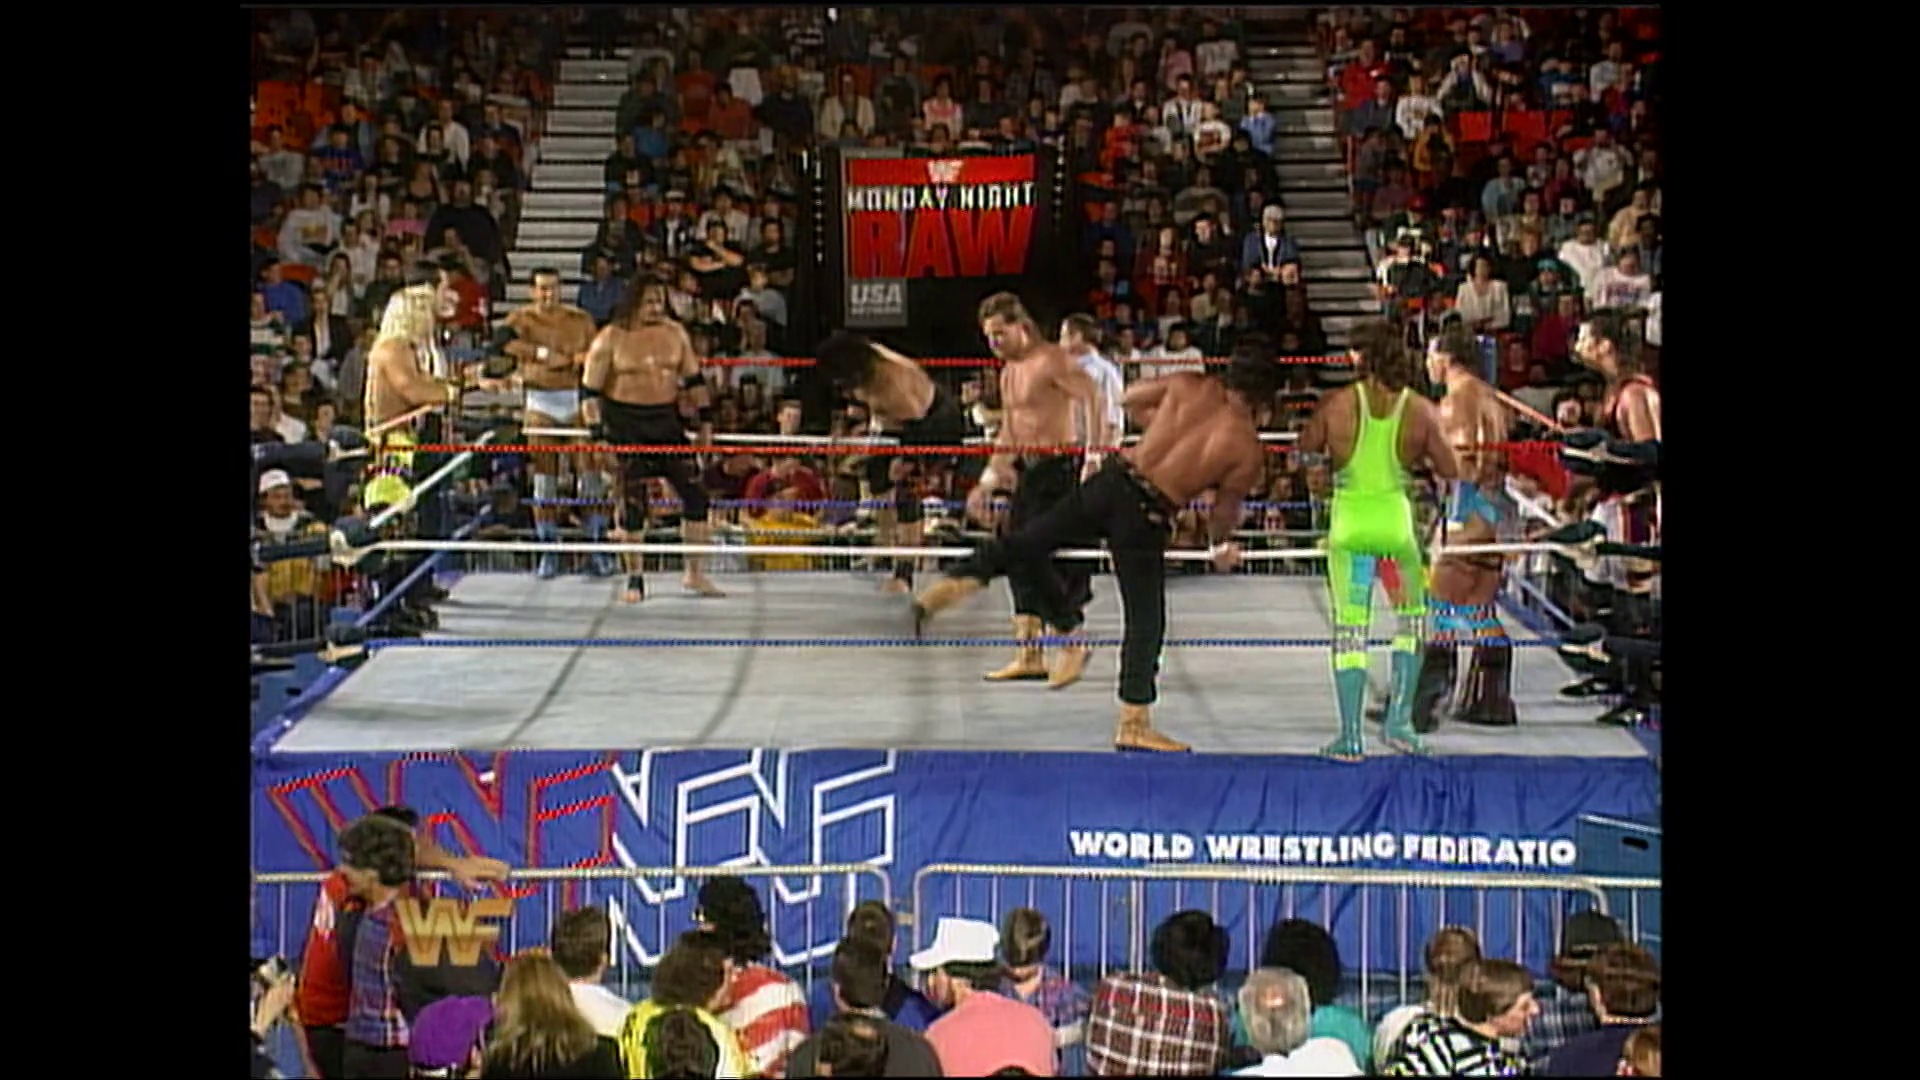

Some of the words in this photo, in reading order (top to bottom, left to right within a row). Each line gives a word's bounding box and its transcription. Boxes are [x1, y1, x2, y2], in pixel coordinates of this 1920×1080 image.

[847, 184, 949, 212] MONDAY
[960, 182, 1034, 209] NIGHT
[851, 206, 1035, 278] RAW
[851, 283, 901, 304] USA
[1070, 831, 1194, 860] WORLD
[1205, 832, 1396, 863] WRESTLING
[1402, 833, 1576, 866] FEDERATIO
